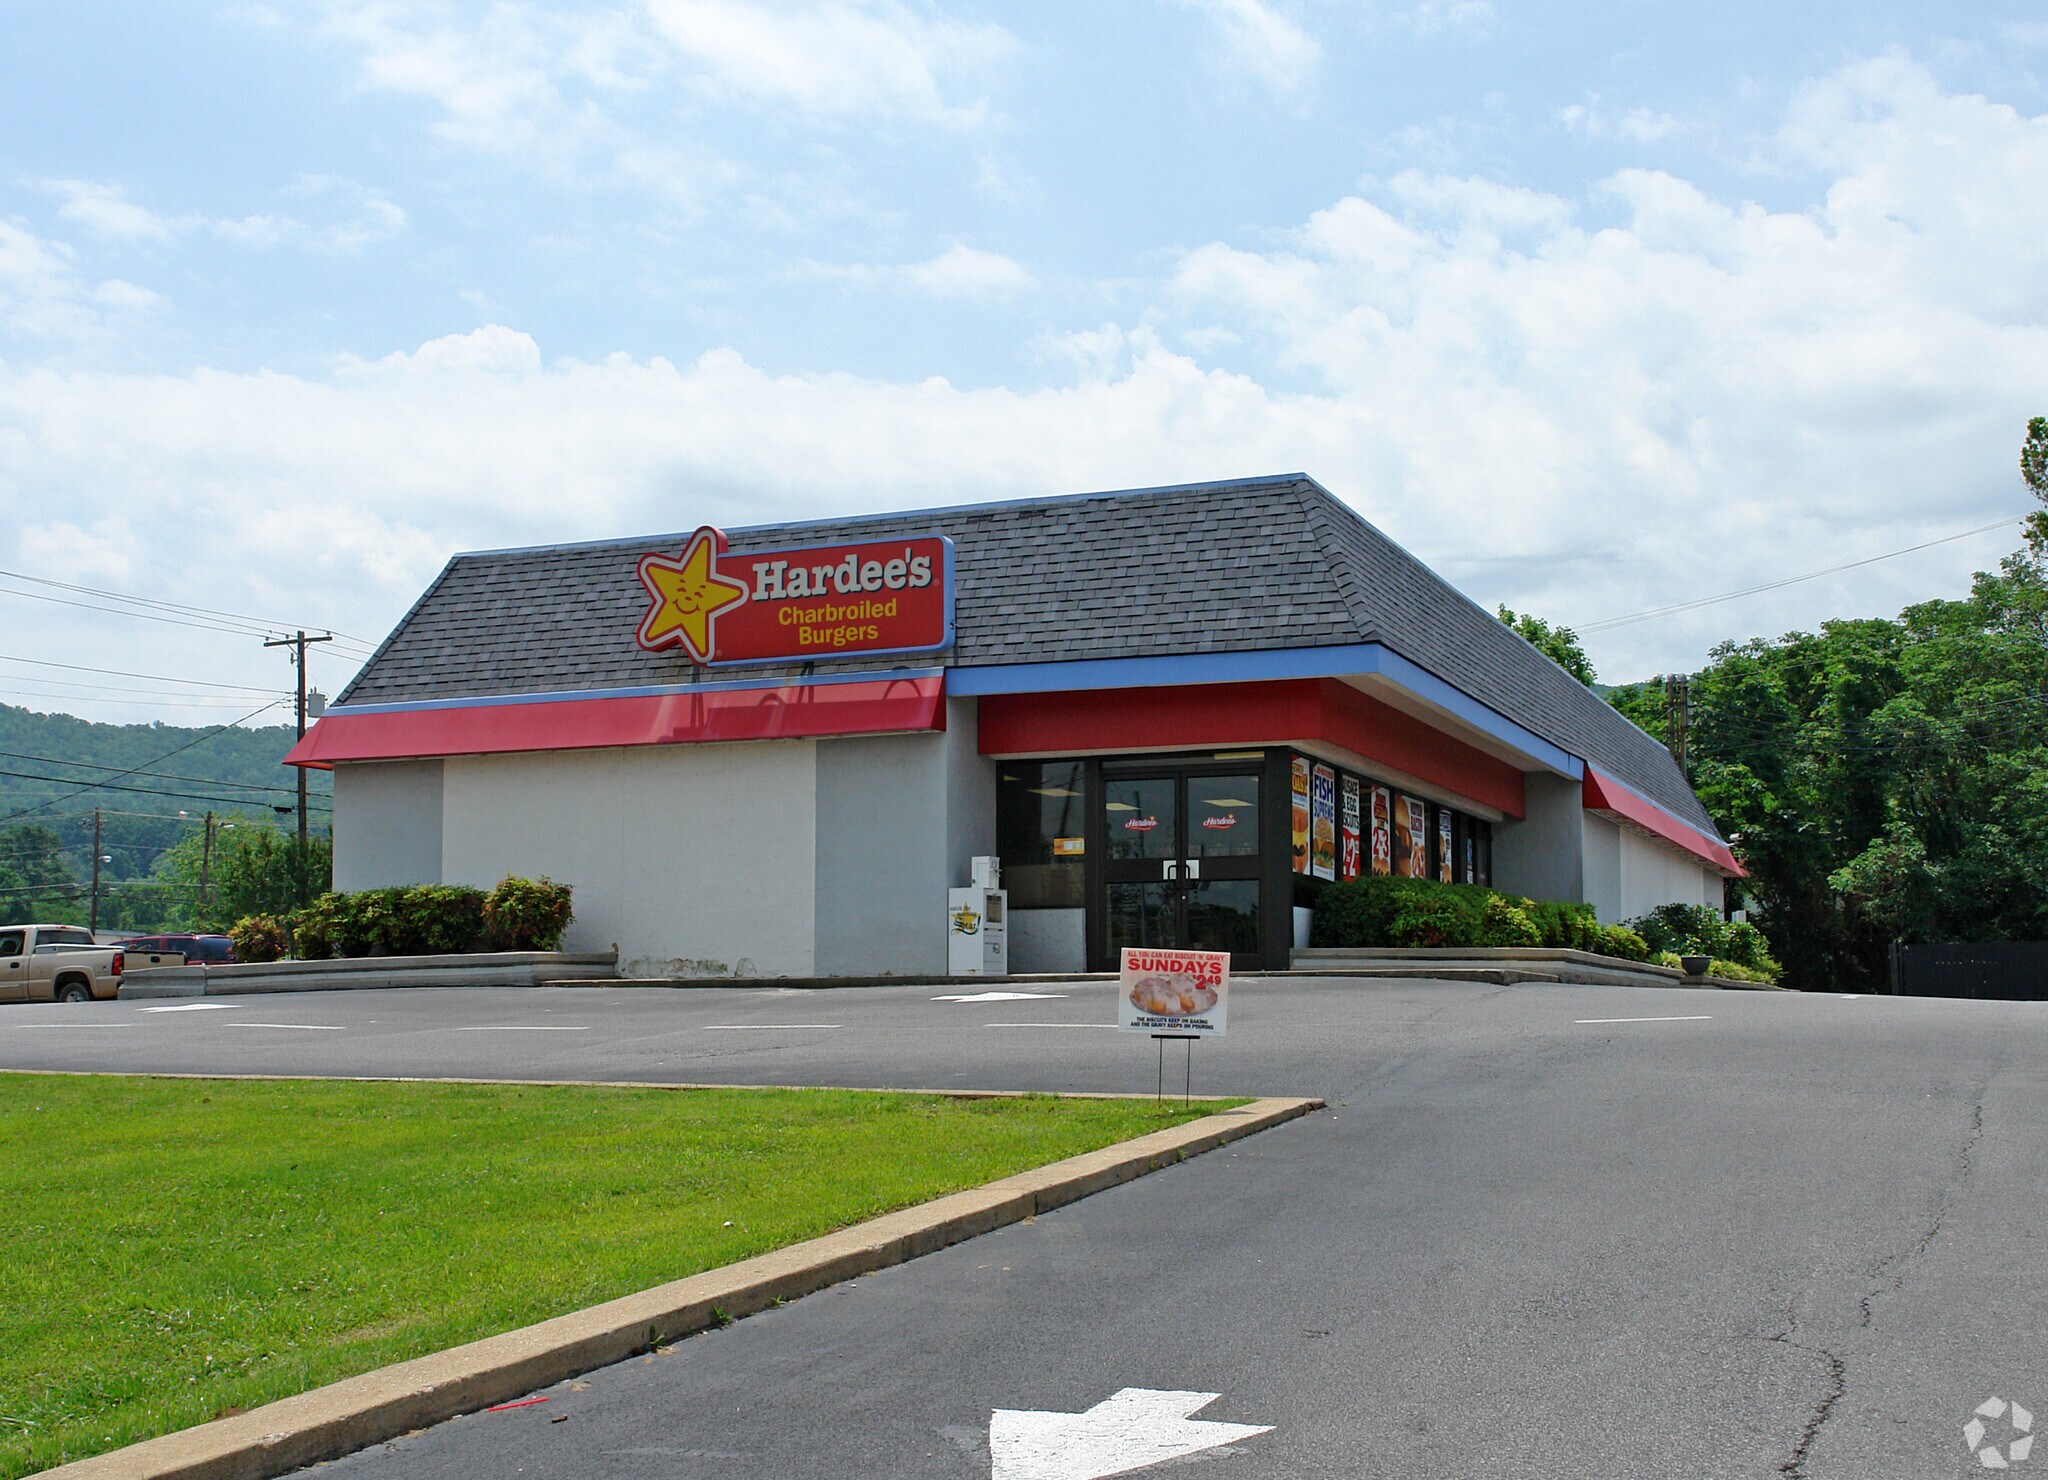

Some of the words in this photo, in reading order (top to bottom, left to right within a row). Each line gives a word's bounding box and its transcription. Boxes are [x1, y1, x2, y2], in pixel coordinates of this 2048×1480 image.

[752, 547, 932, 602] Hardee's
[778, 597, 897, 626] Charbroiled
[799, 623, 878, 647] Burgers
[1314, 773, 1334, 804] FISH
[1314, 798, 1334, 823] SUPREME
[1127, 958, 1222, 975] SUNDAYS
[1139, 950, 1149, 958] YOU
[1151, 951, 1163, 959] CAN
